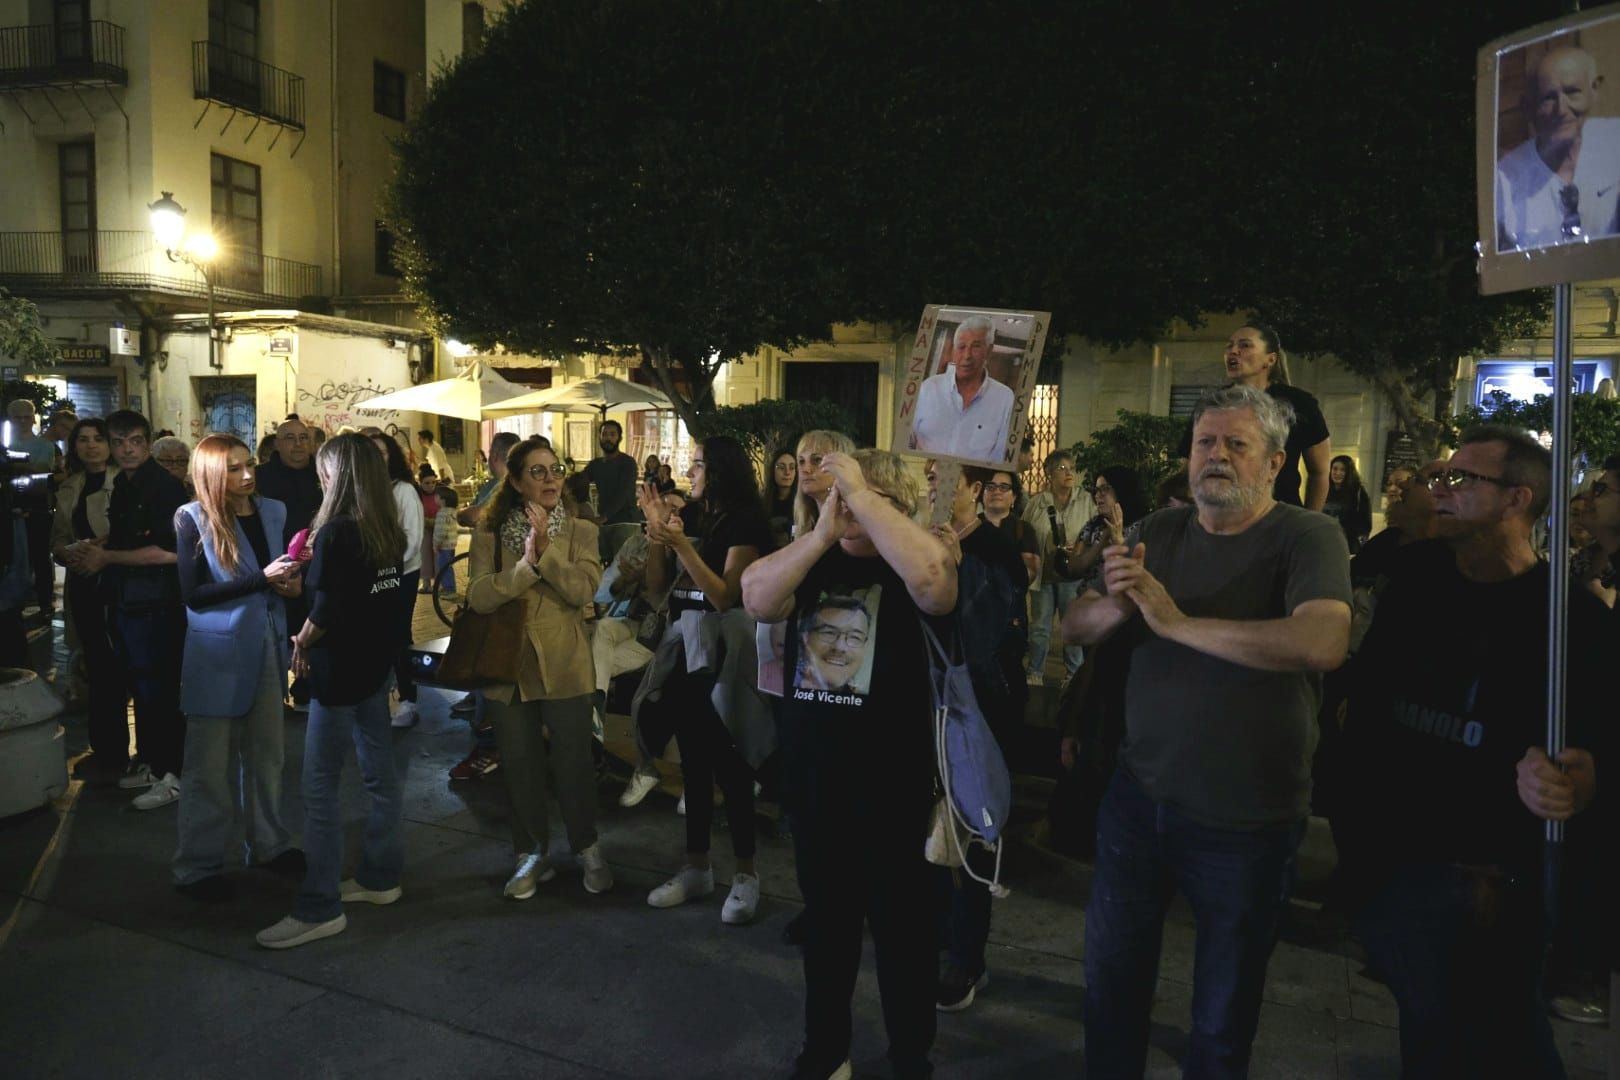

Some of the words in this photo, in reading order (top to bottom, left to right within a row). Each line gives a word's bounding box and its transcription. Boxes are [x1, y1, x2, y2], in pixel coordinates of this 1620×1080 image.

[900, 315, 933, 419] MAZÓN
[793, 688, 815, 701] José
[817, 691, 863, 706] Vicente
